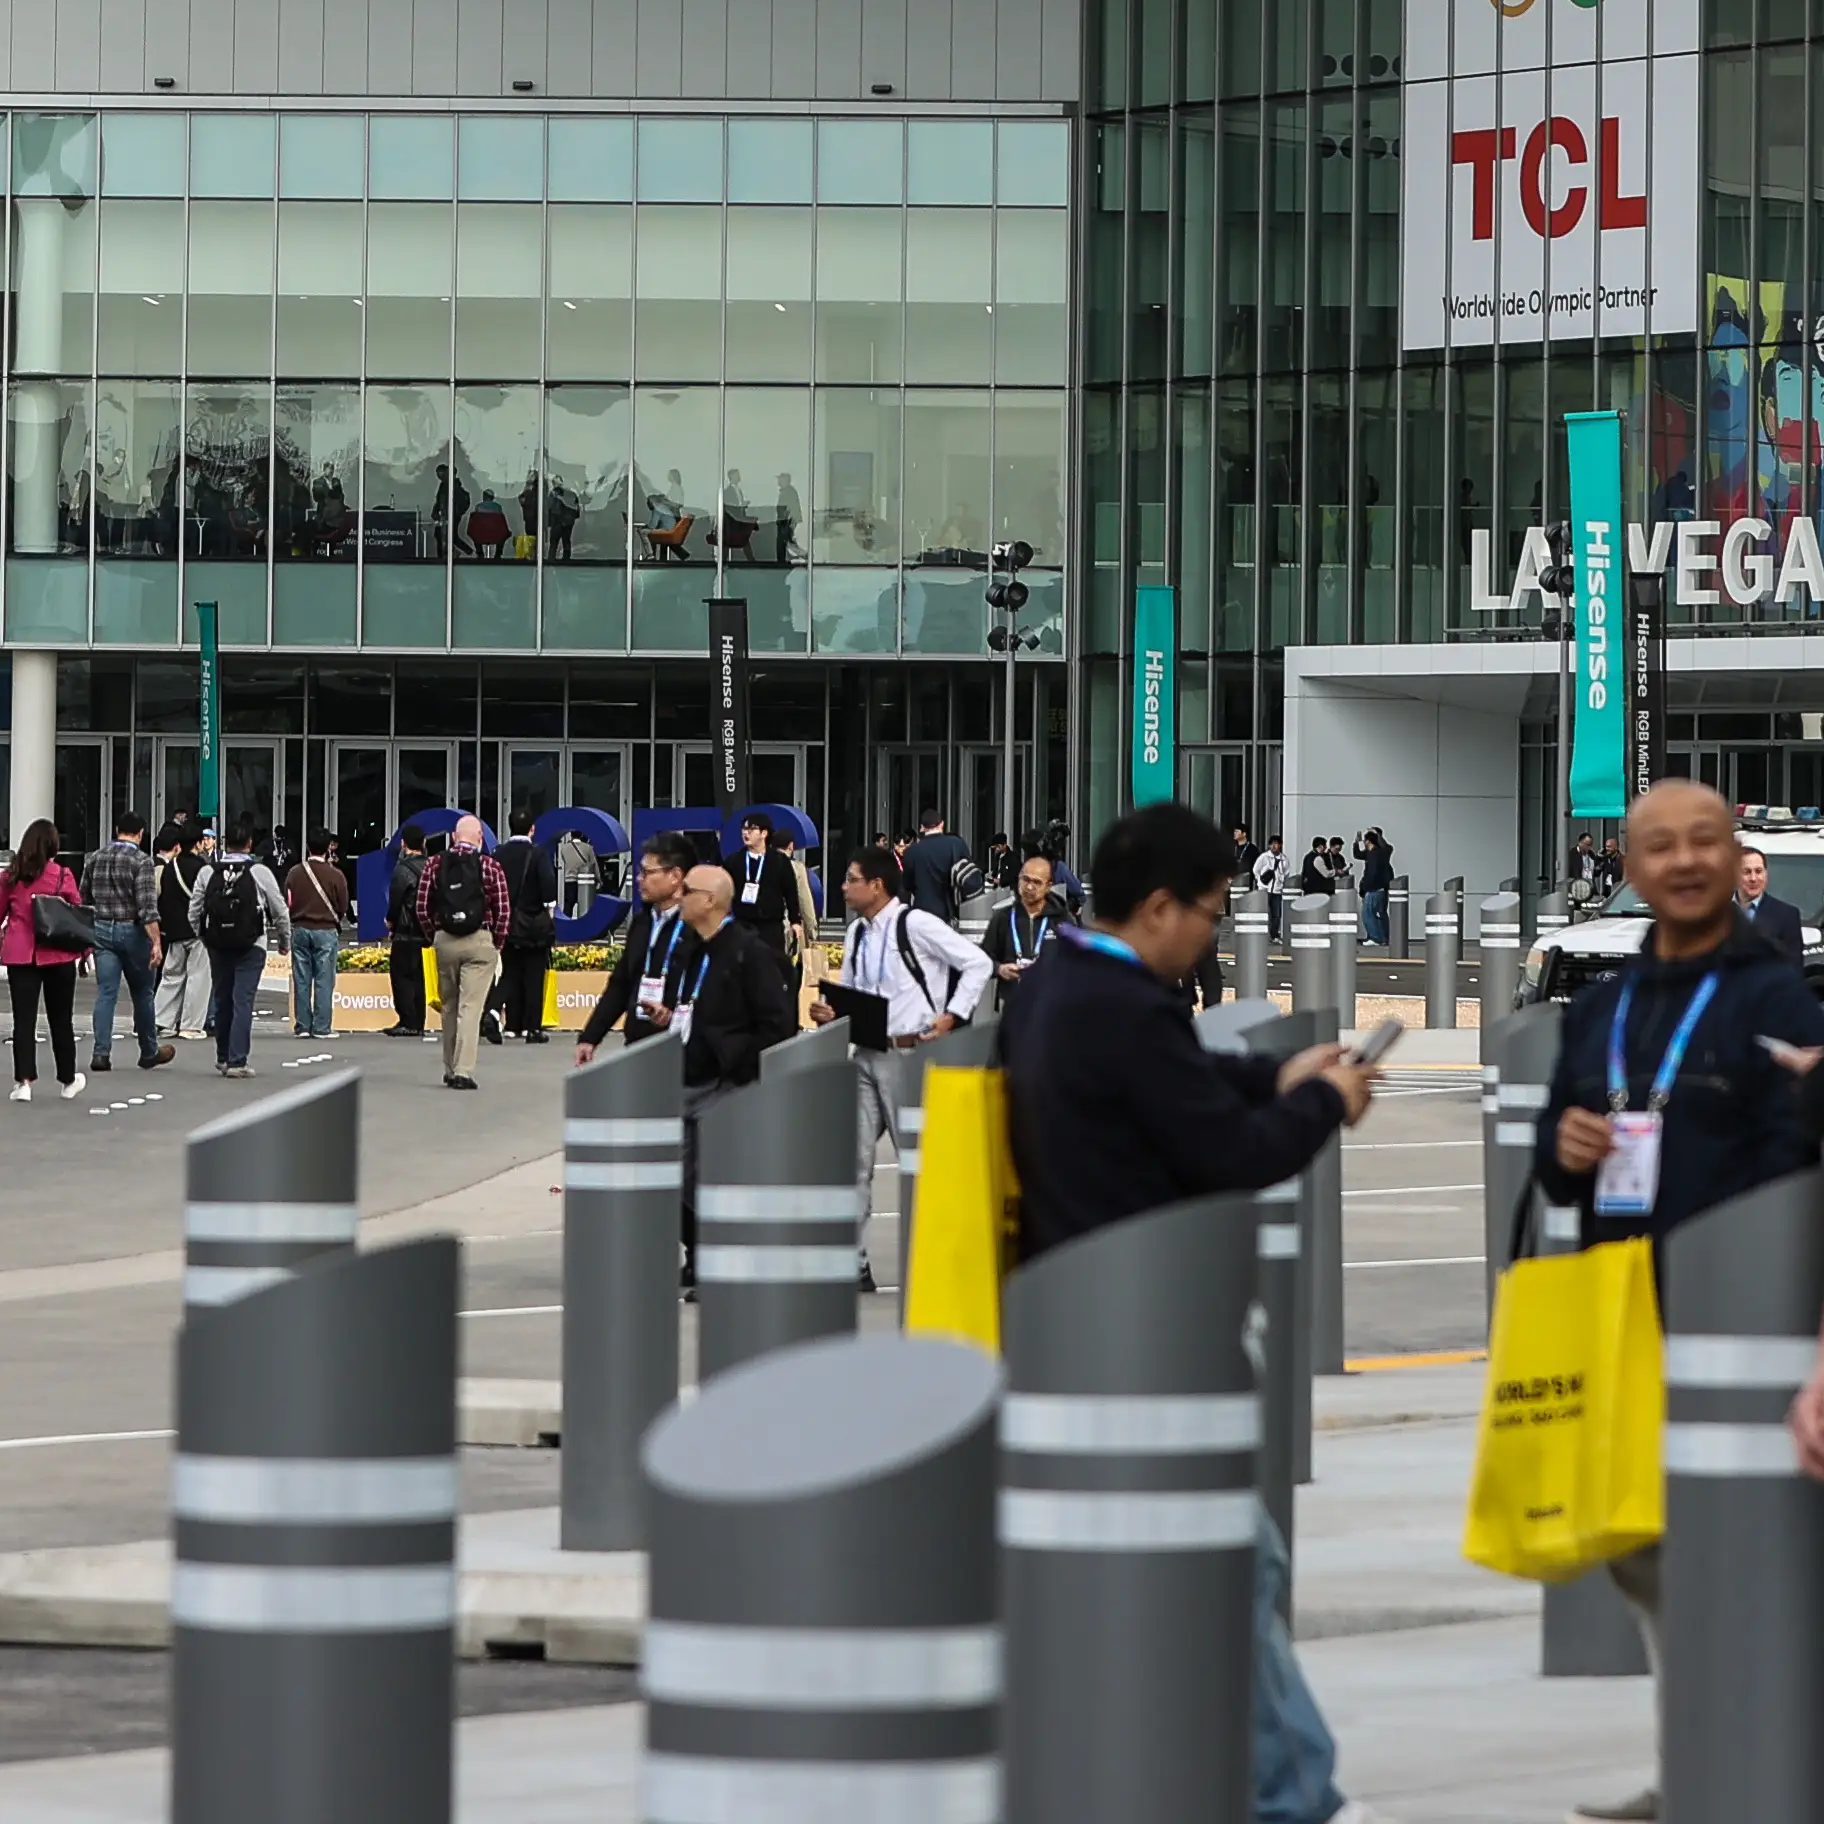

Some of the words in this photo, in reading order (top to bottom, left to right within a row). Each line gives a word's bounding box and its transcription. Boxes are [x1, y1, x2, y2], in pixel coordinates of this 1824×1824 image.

[1450, 115, 1649, 240] TCL
[1470, 521, 1576, 611] LA
[1584, 519, 1610, 710] Hisense
[1636, 612, 1649, 698] Hisense
[201, 659, 211, 761] Hisense
[721, 634, 734, 709] Hisense
[1143, 649, 1164, 765] Hisense
[723, 718, 735, 747] RGB
[1637, 709, 1650, 742] RGB
